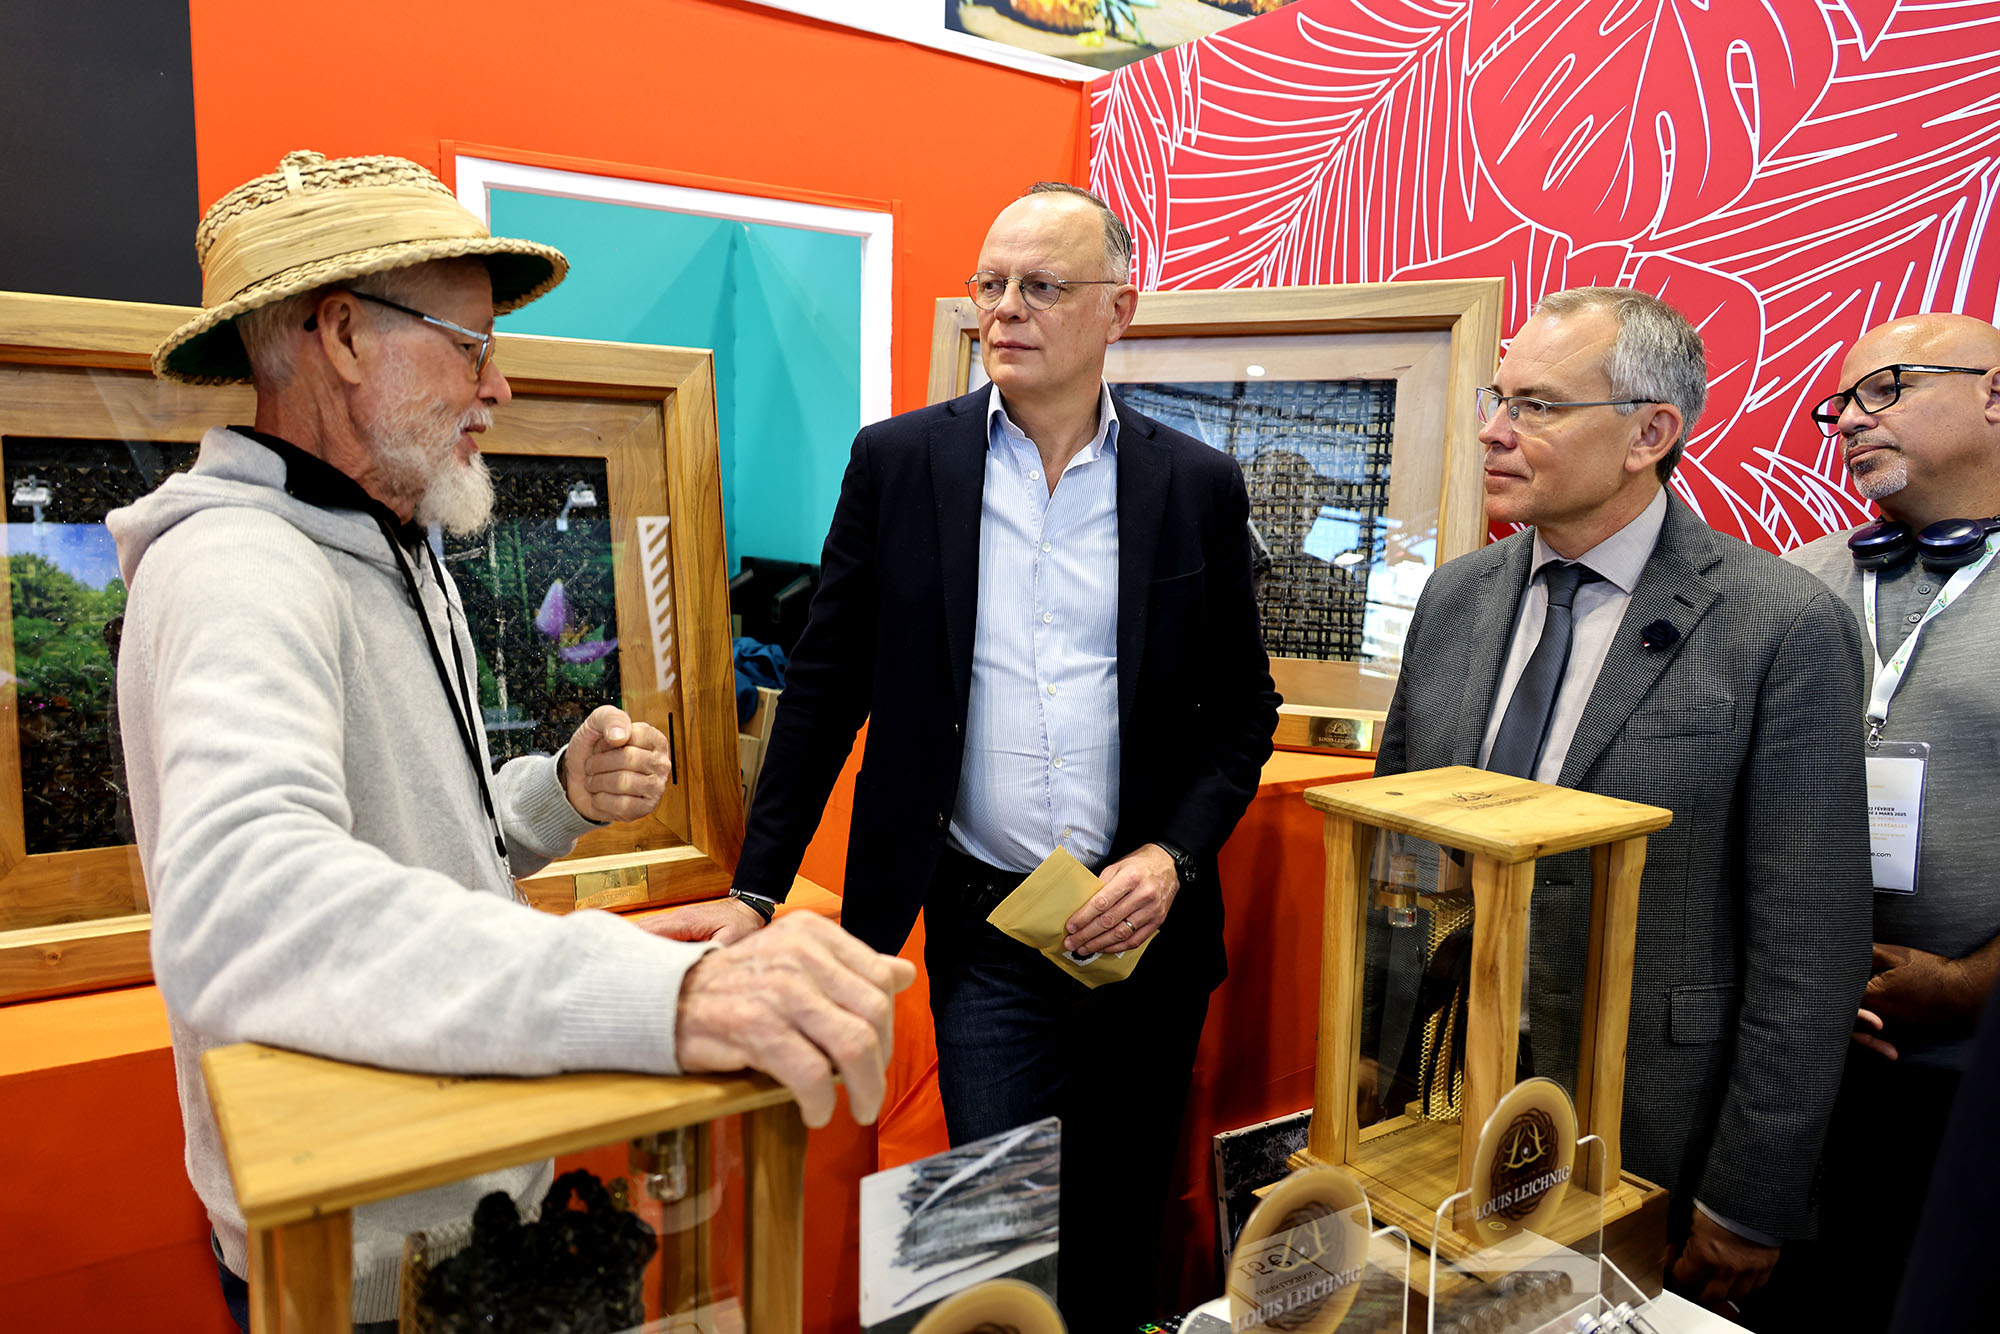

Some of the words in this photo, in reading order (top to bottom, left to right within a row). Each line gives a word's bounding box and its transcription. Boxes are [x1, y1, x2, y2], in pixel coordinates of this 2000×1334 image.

[1475, 1191, 1512, 1221] LOUIS
[1514, 1165, 1571, 1202] LEICHNIG
[1232, 1298, 1284, 1334] LOUIS
[1286, 1264, 1361, 1310] LEICHNIG
